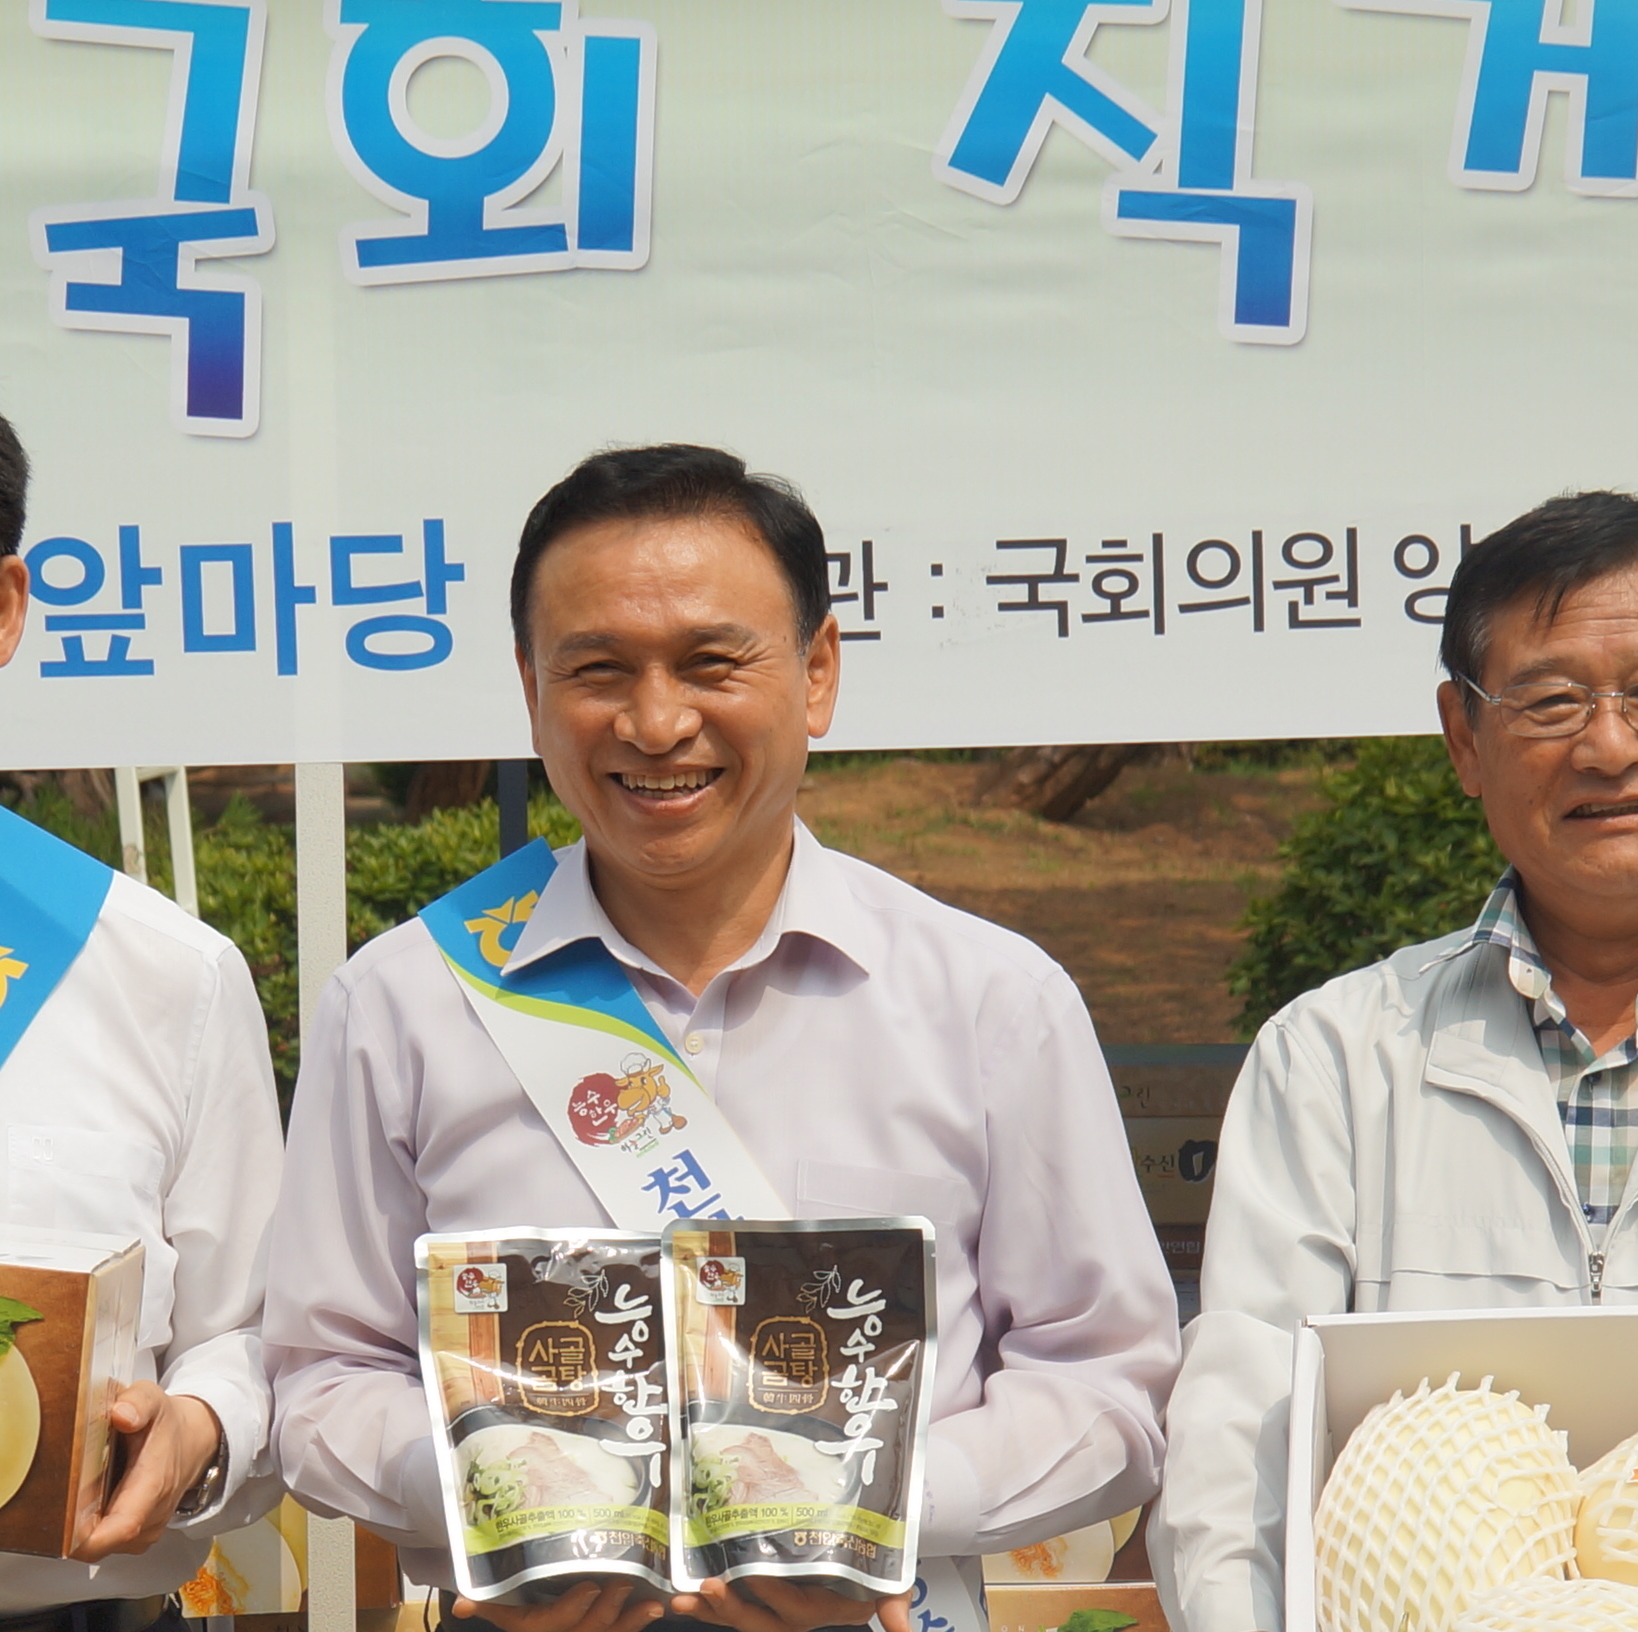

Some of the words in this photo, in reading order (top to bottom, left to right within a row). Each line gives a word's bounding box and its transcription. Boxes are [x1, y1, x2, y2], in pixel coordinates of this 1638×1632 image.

[43, 0, 640, 419] 국회
[29, 518, 465, 679] 앞마당
[986, 526, 1362, 638] 국회의원
[761, 1332, 817, 1360] 사골
[761, 1361, 819, 1388] 곰탕
